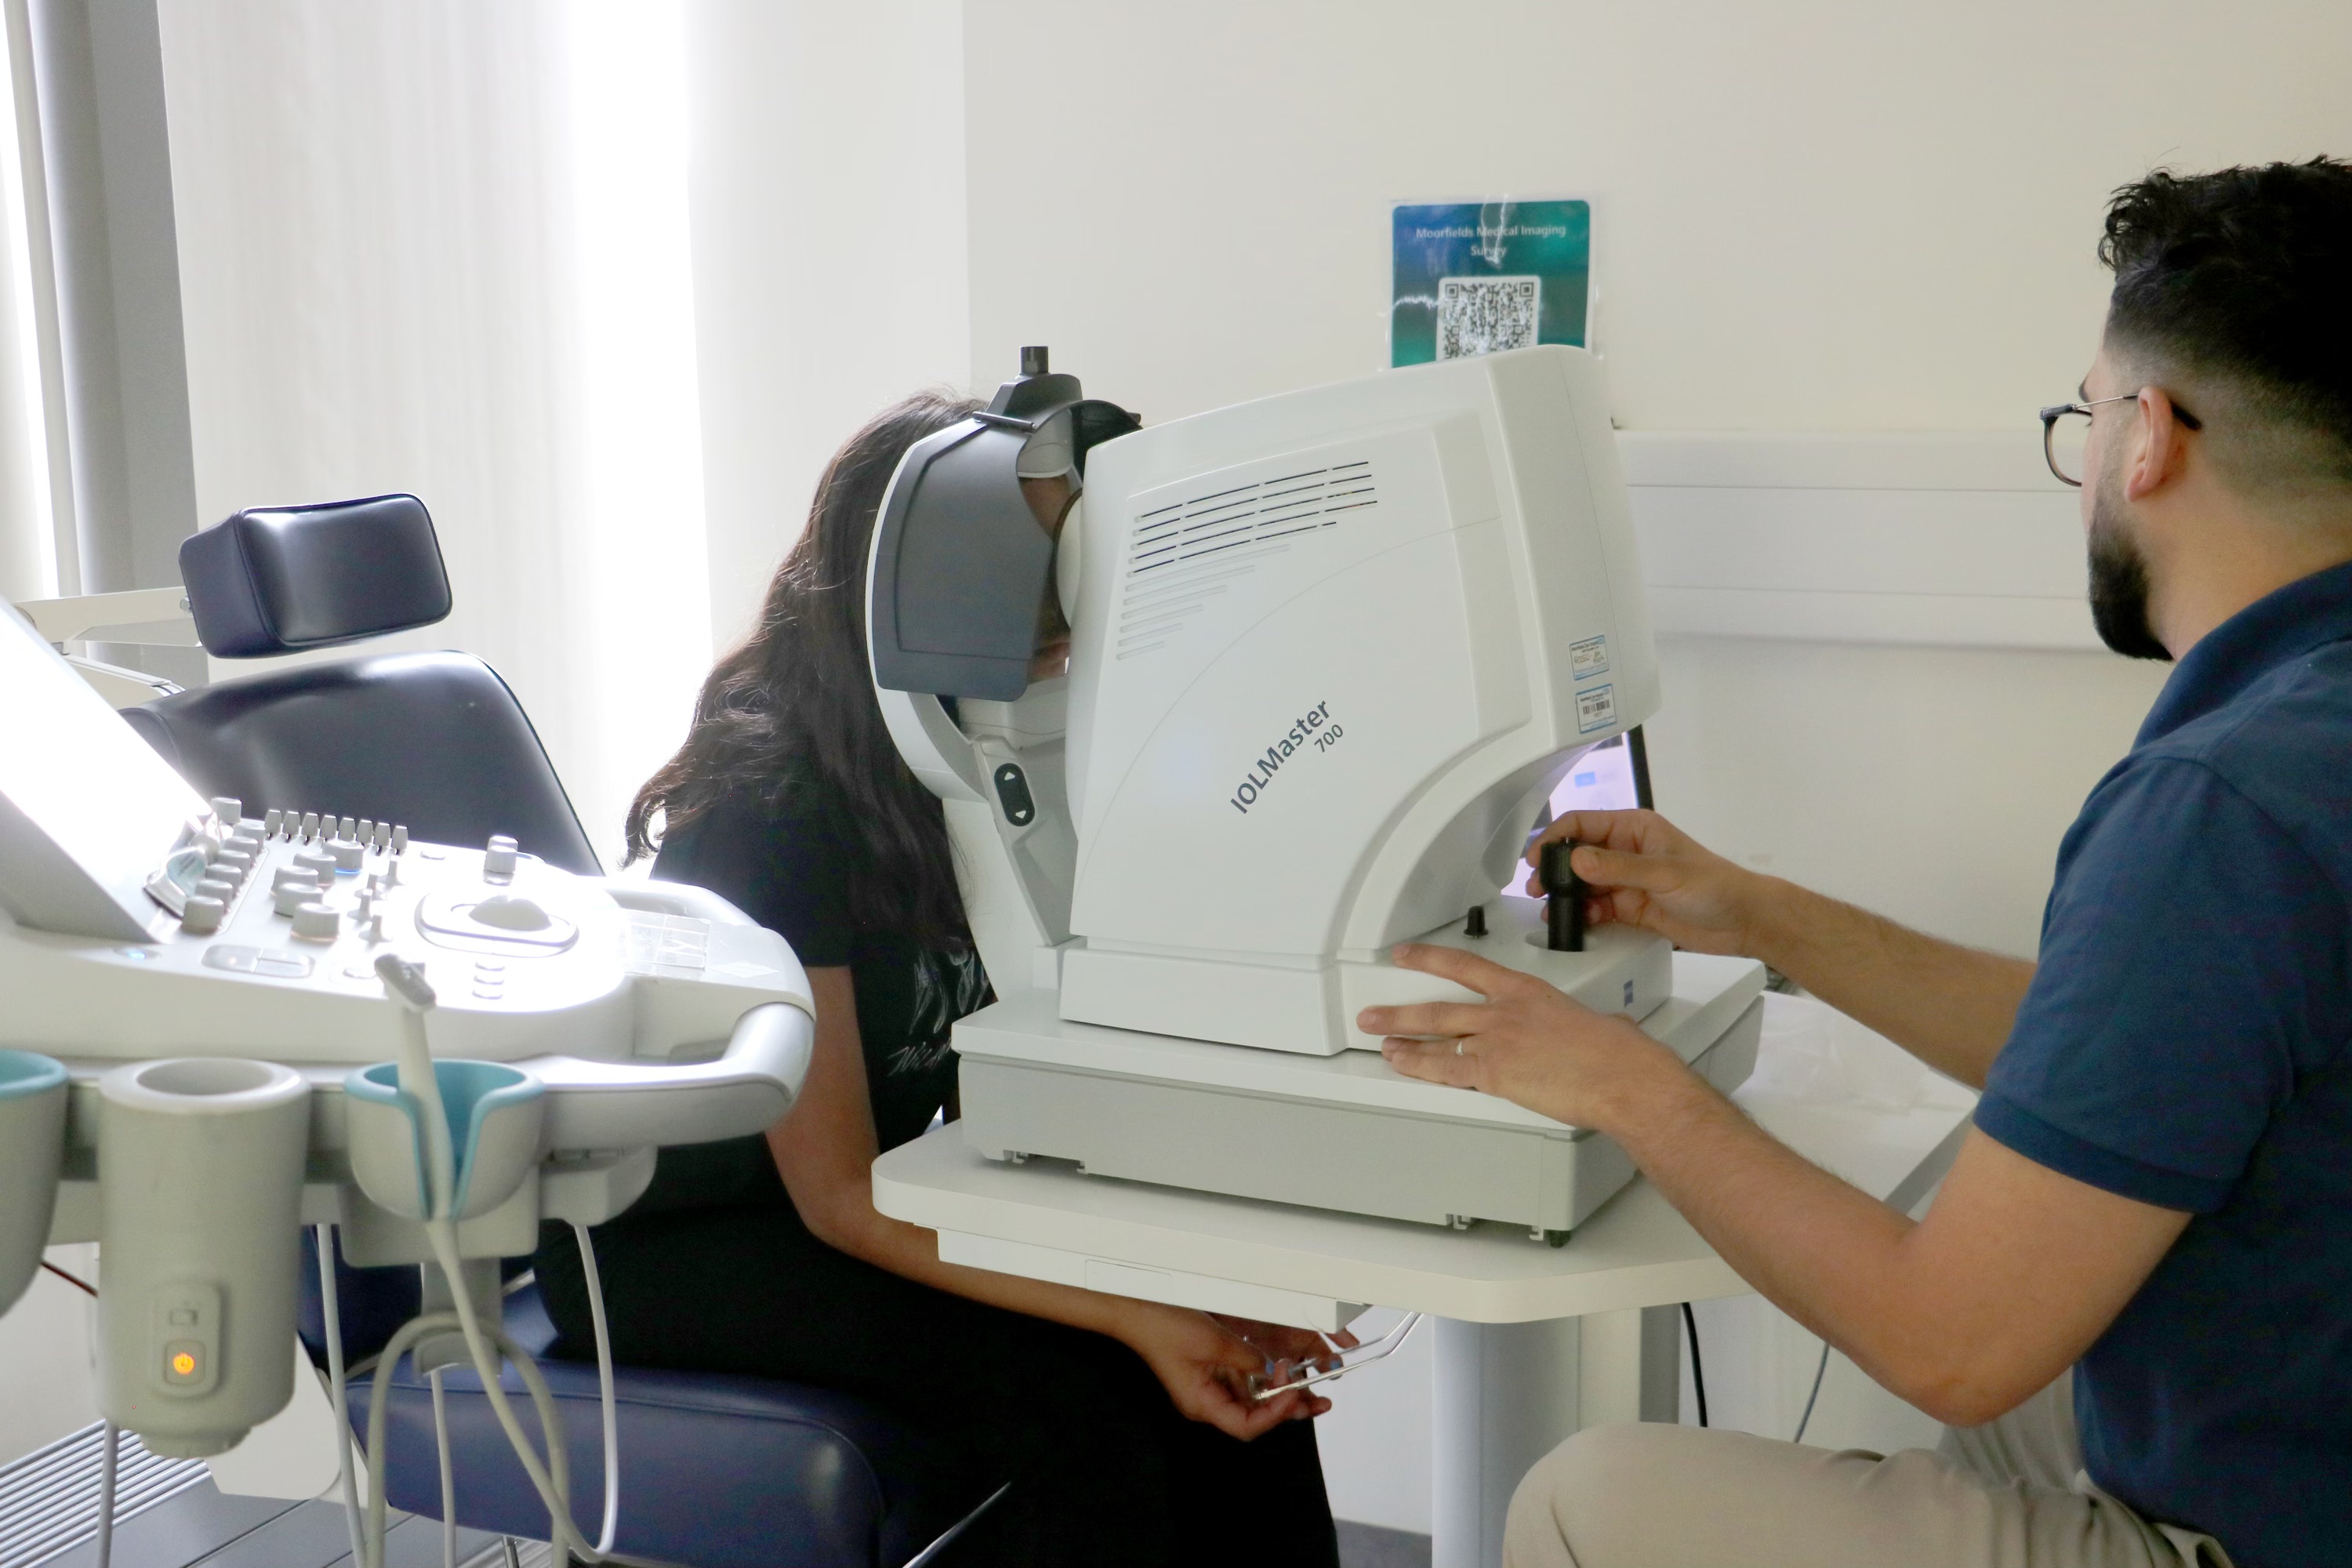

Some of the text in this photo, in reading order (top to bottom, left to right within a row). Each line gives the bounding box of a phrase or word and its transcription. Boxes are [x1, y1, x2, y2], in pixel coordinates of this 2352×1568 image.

[1416, 225, 1566, 238] Moorfields Medical Imaging
[1470, 245, 1507, 257] Survey
[1314, 724, 1344, 753] 700
[1230, 700, 1330, 815] IOLMaster
